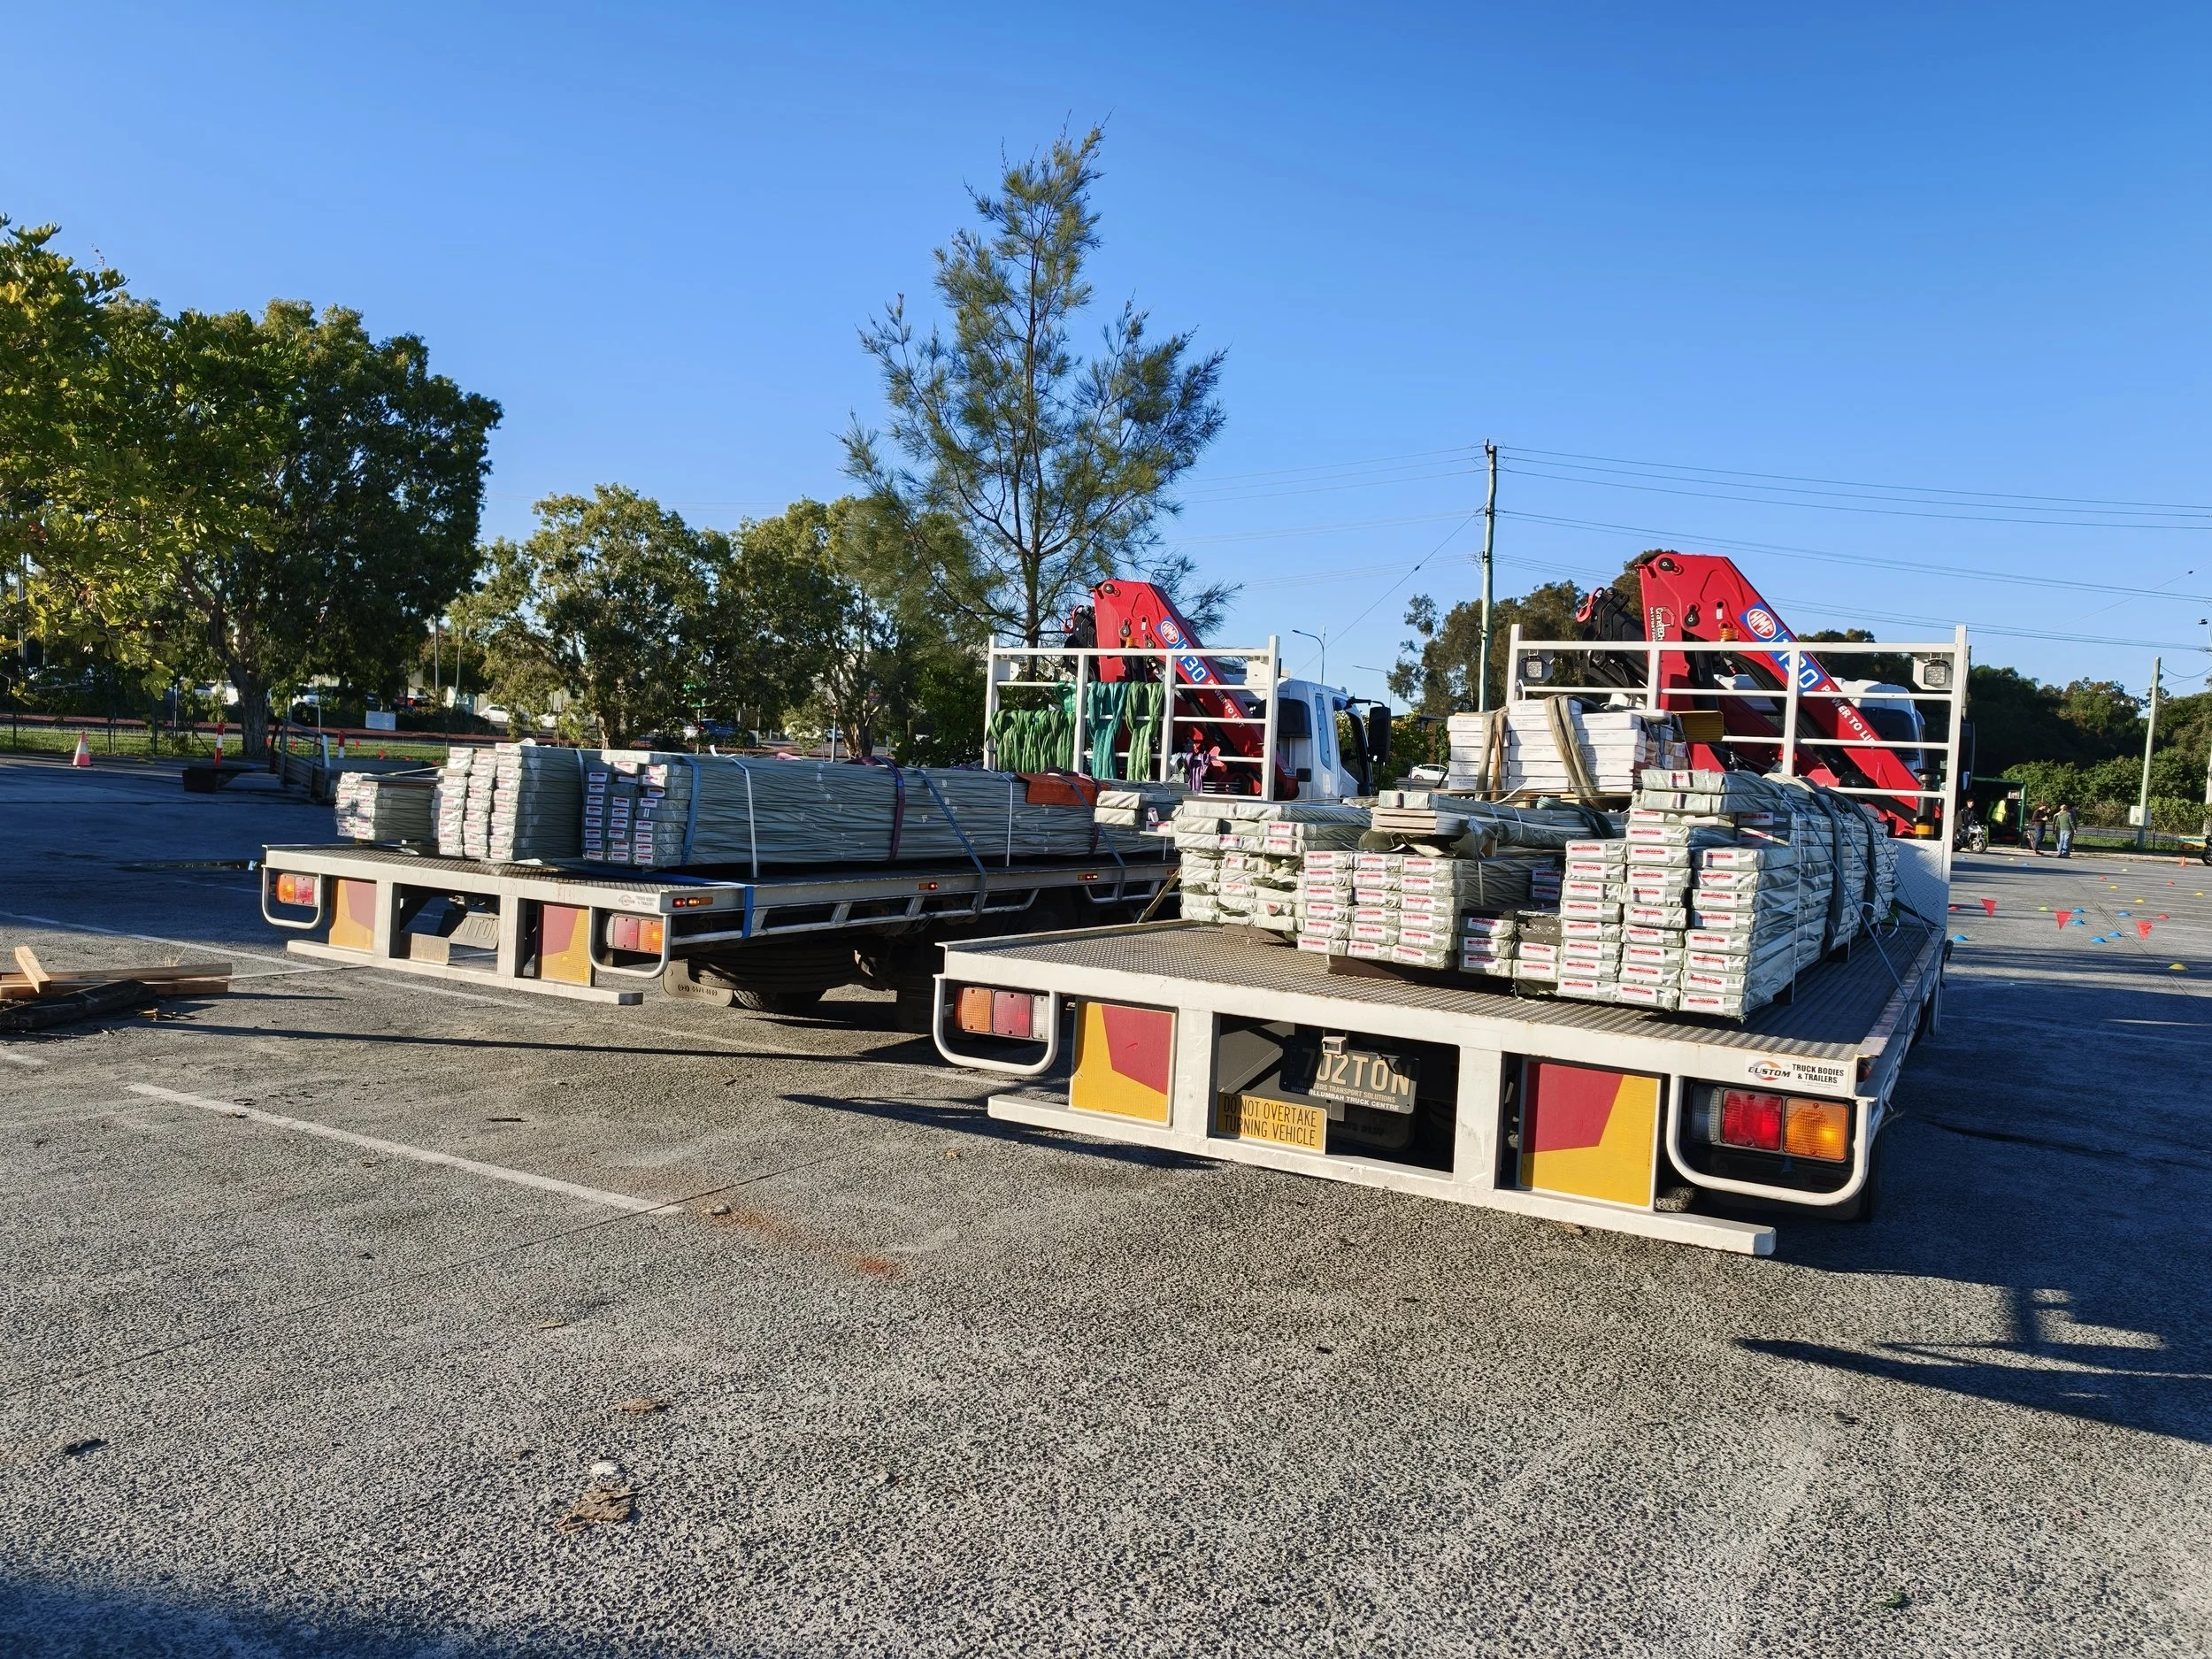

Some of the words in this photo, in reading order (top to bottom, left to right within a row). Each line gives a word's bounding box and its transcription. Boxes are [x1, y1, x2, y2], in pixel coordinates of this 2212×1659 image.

[1749, 612, 1775, 635] HMF
[1162, 624, 1178, 642] HMF
[1225, 703, 1234, 714] TO
[1820, 684, 1852, 718] PWER
[1848, 715, 1863, 731] TO
[1747, 1066, 1791, 1078] CUSTOM
[1793, 1064, 1816, 1073] TRUCK
[1817, 1066, 1845, 1077] BODIES
[1804, 1072, 1838, 1084] TRAILERS
[1328, 1085, 1363, 1097] TRANSPORT
[1363, 1091, 1396, 1103] SOLUTIONS
[1346, 1095, 1370, 1106] TRUCK
[1371, 1101, 1400, 1111] CENTRE
[1224, 1095, 1238, 1114] DO
[1240, 1099, 1261, 1118] NOT
[1263, 1102, 1317, 1128] OVERTAKE
[1225, 1115, 1268, 1138] TURNING
[1272, 1123, 1316, 1147] VEHICLE
